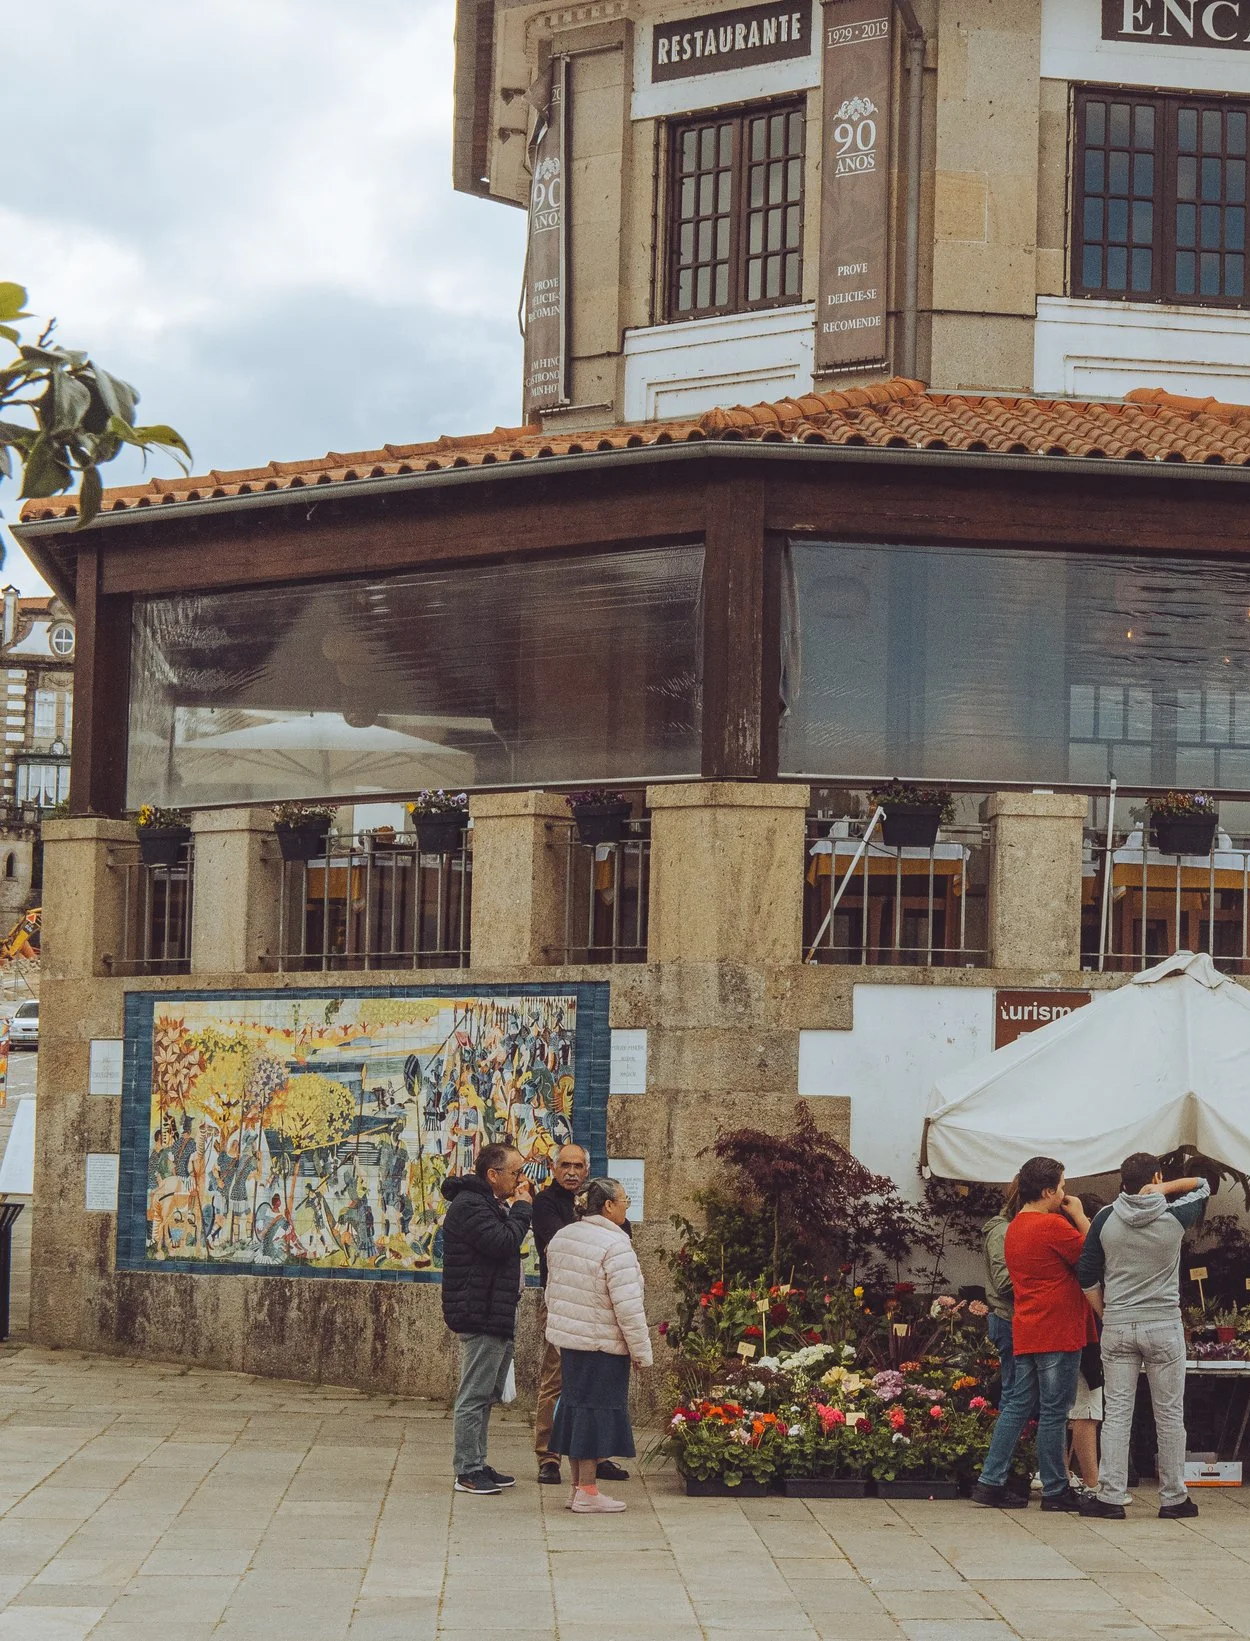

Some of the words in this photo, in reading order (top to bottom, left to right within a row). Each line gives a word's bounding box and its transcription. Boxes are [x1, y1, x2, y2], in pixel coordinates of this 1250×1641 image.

[657, 12, 802, 65] RESTAURANTE
[827, 27, 853, 45] 1929
[861, 21, 889, 38] 2019
[833, 119, 877, 156] 90
[834, 153, 876, 174] ANOS
[836, 262, 868, 277] PROVE
[827, 288, 878, 306] DELICIE-SE
[823, 315, 882, 334] RECOMENDE
[1000, 1001, 1072, 1021] turism
